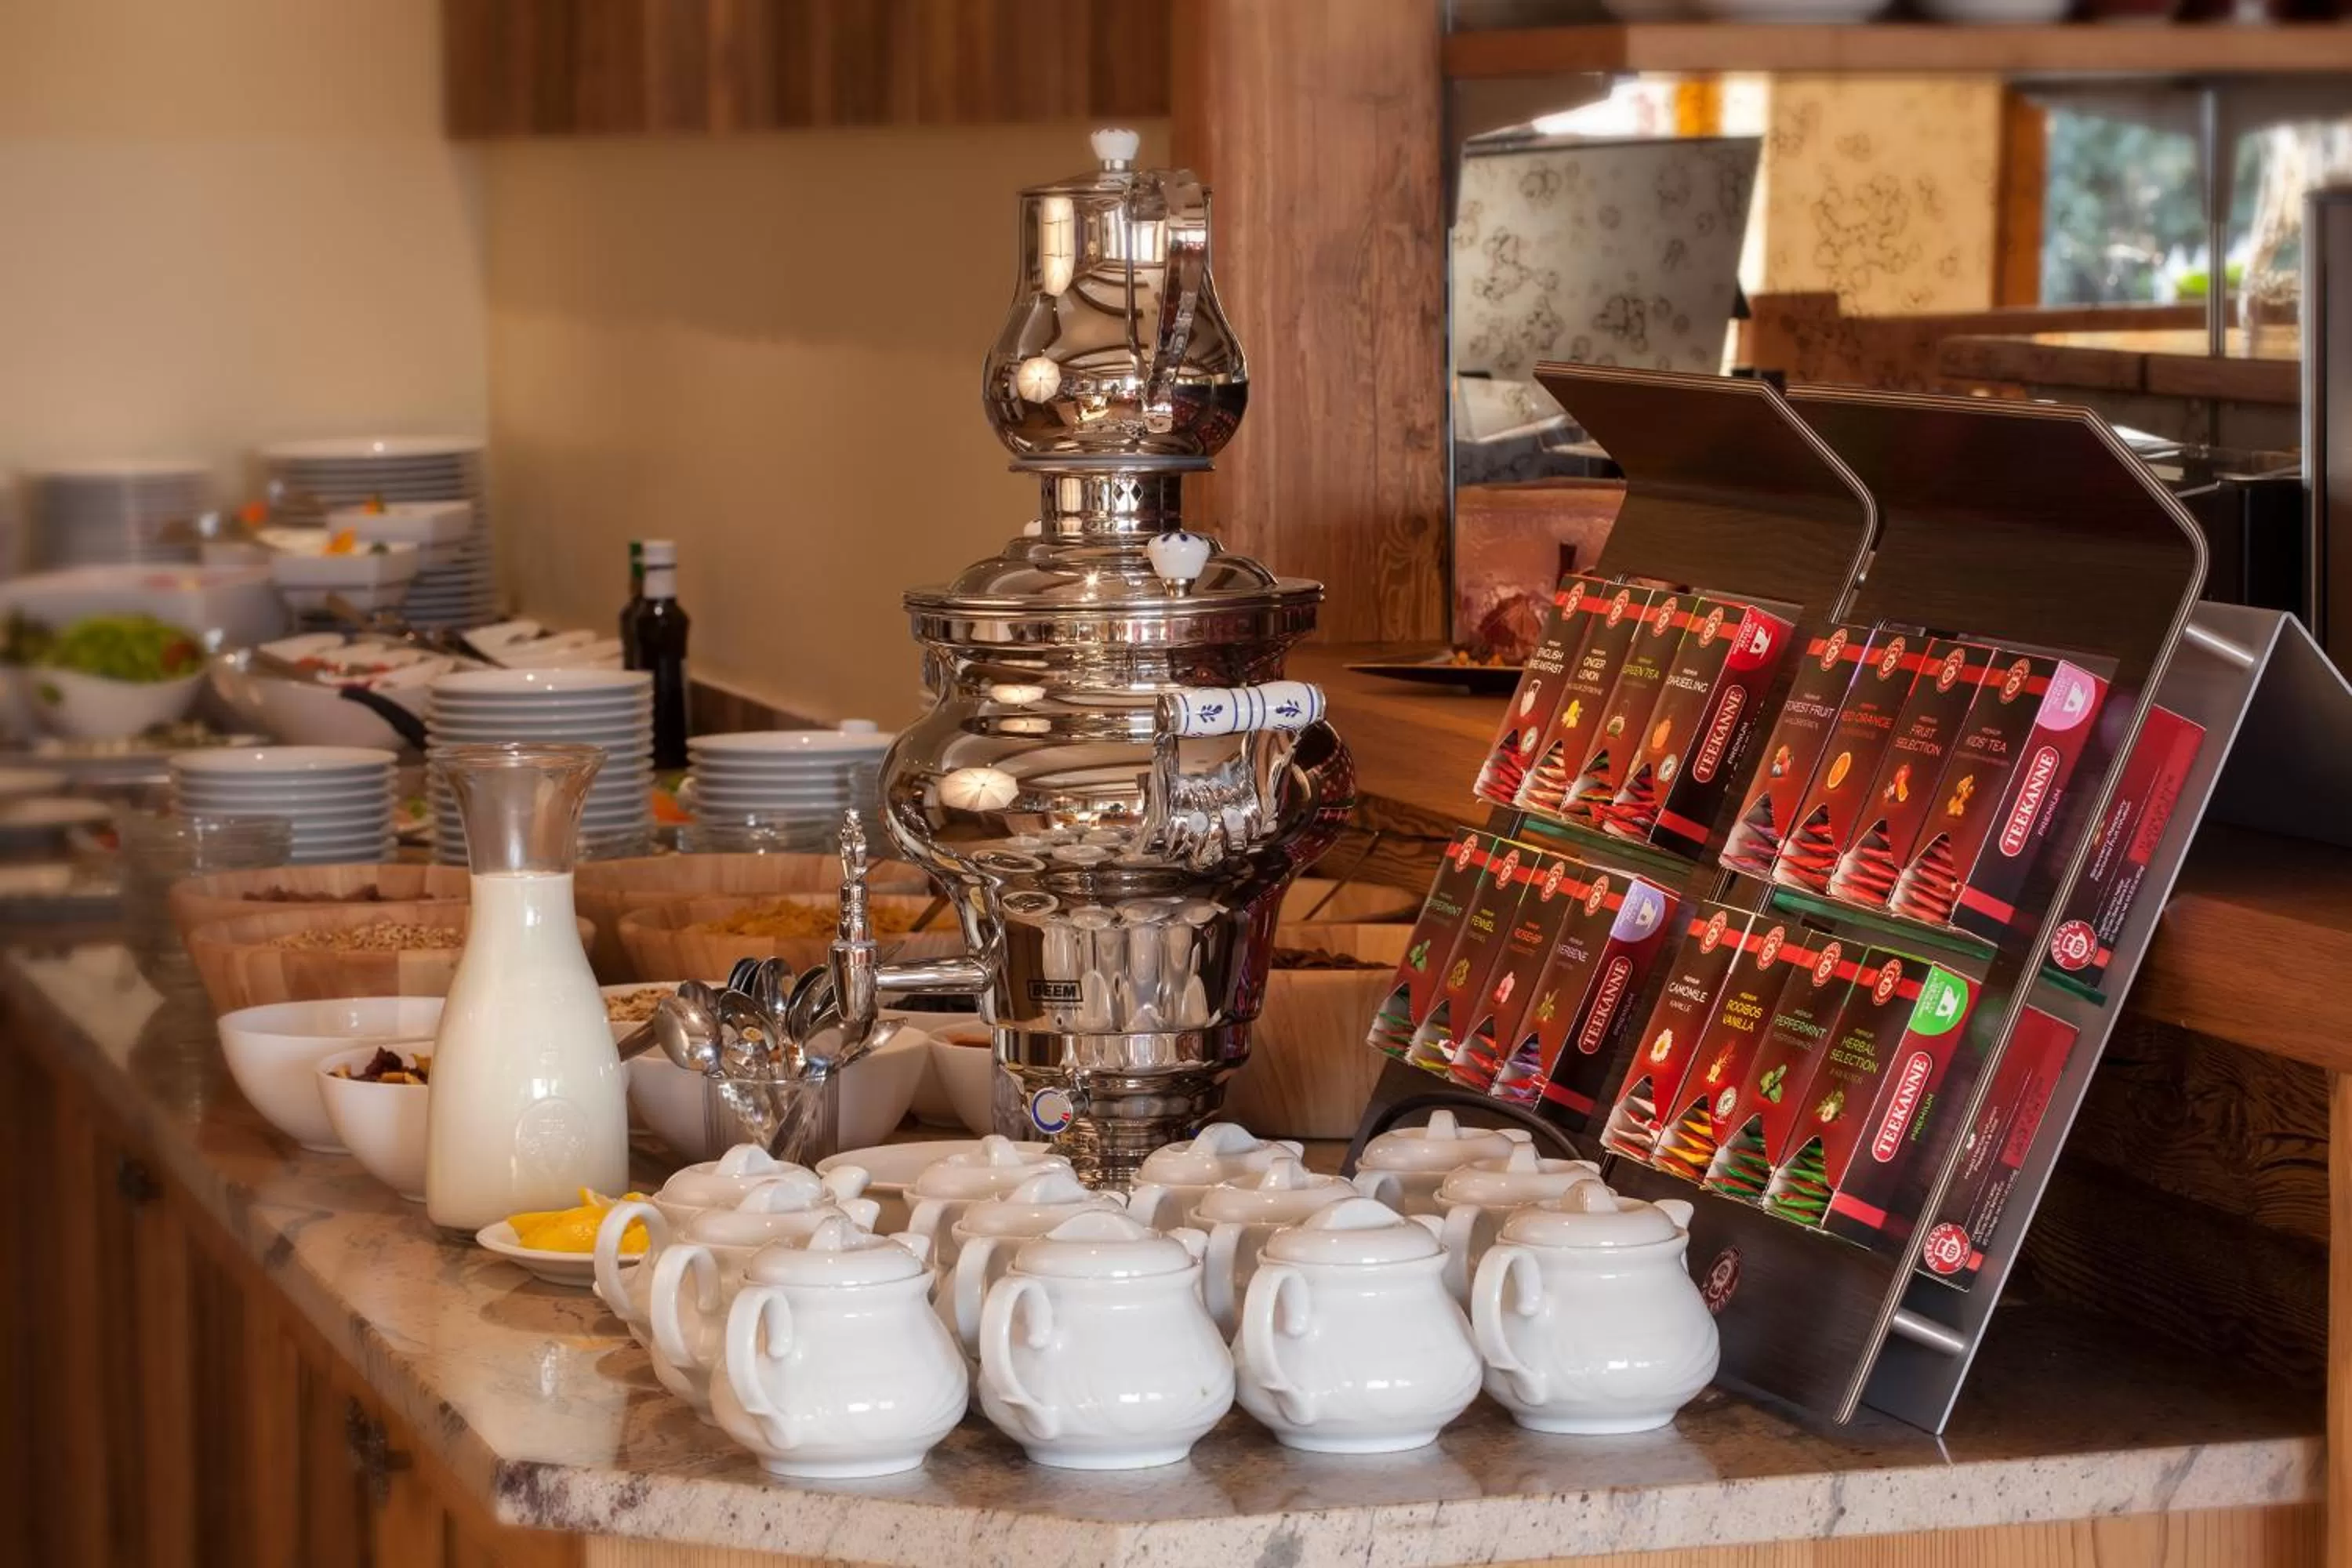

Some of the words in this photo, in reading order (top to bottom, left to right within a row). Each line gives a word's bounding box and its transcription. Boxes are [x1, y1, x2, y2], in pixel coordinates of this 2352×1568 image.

[1697, 691, 1742, 775] TEEKANNE
[2005, 753, 2055, 848] TEEKANNE
[1033, 985, 1076, 998] BEEM
[1584, 962, 1629, 1047] TEEKANNE
[1774, 1013, 1828, 1039] PEPPERMINT
[1841, 1036, 1876, 1057] HERBAL
[1829, 1048, 1879, 1074] SELECTION
[1878, 1058, 1928, 1155] TEEKANNE
